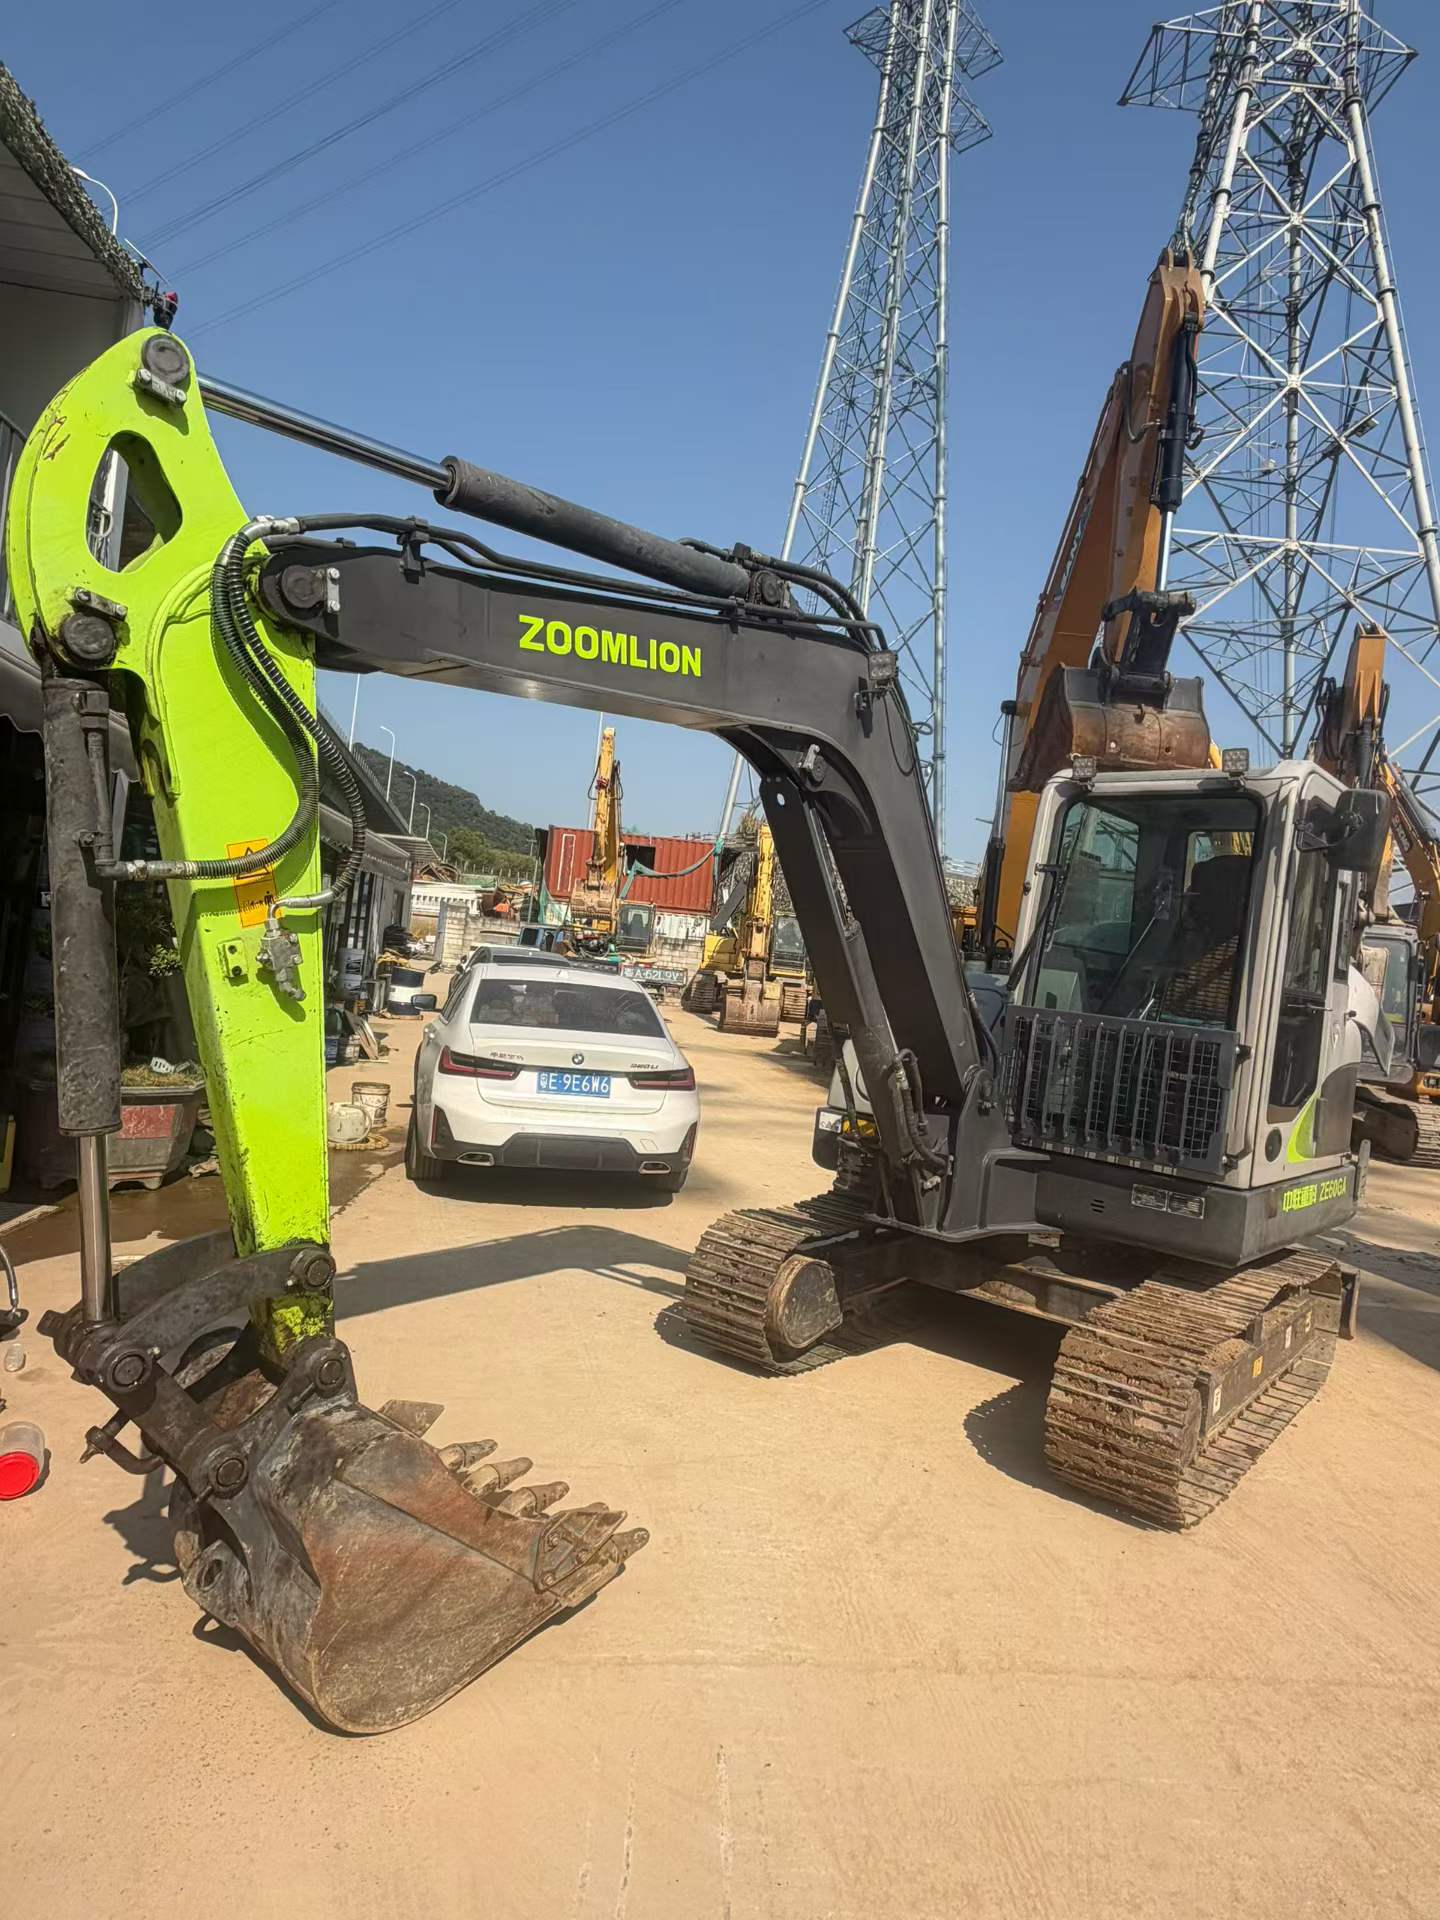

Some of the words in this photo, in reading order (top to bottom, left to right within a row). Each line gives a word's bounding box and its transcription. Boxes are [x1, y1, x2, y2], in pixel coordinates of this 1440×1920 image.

[518, 614, 702, 678] ZOOMLION
[1282, 1184, 1318, 1212] 中联重科
